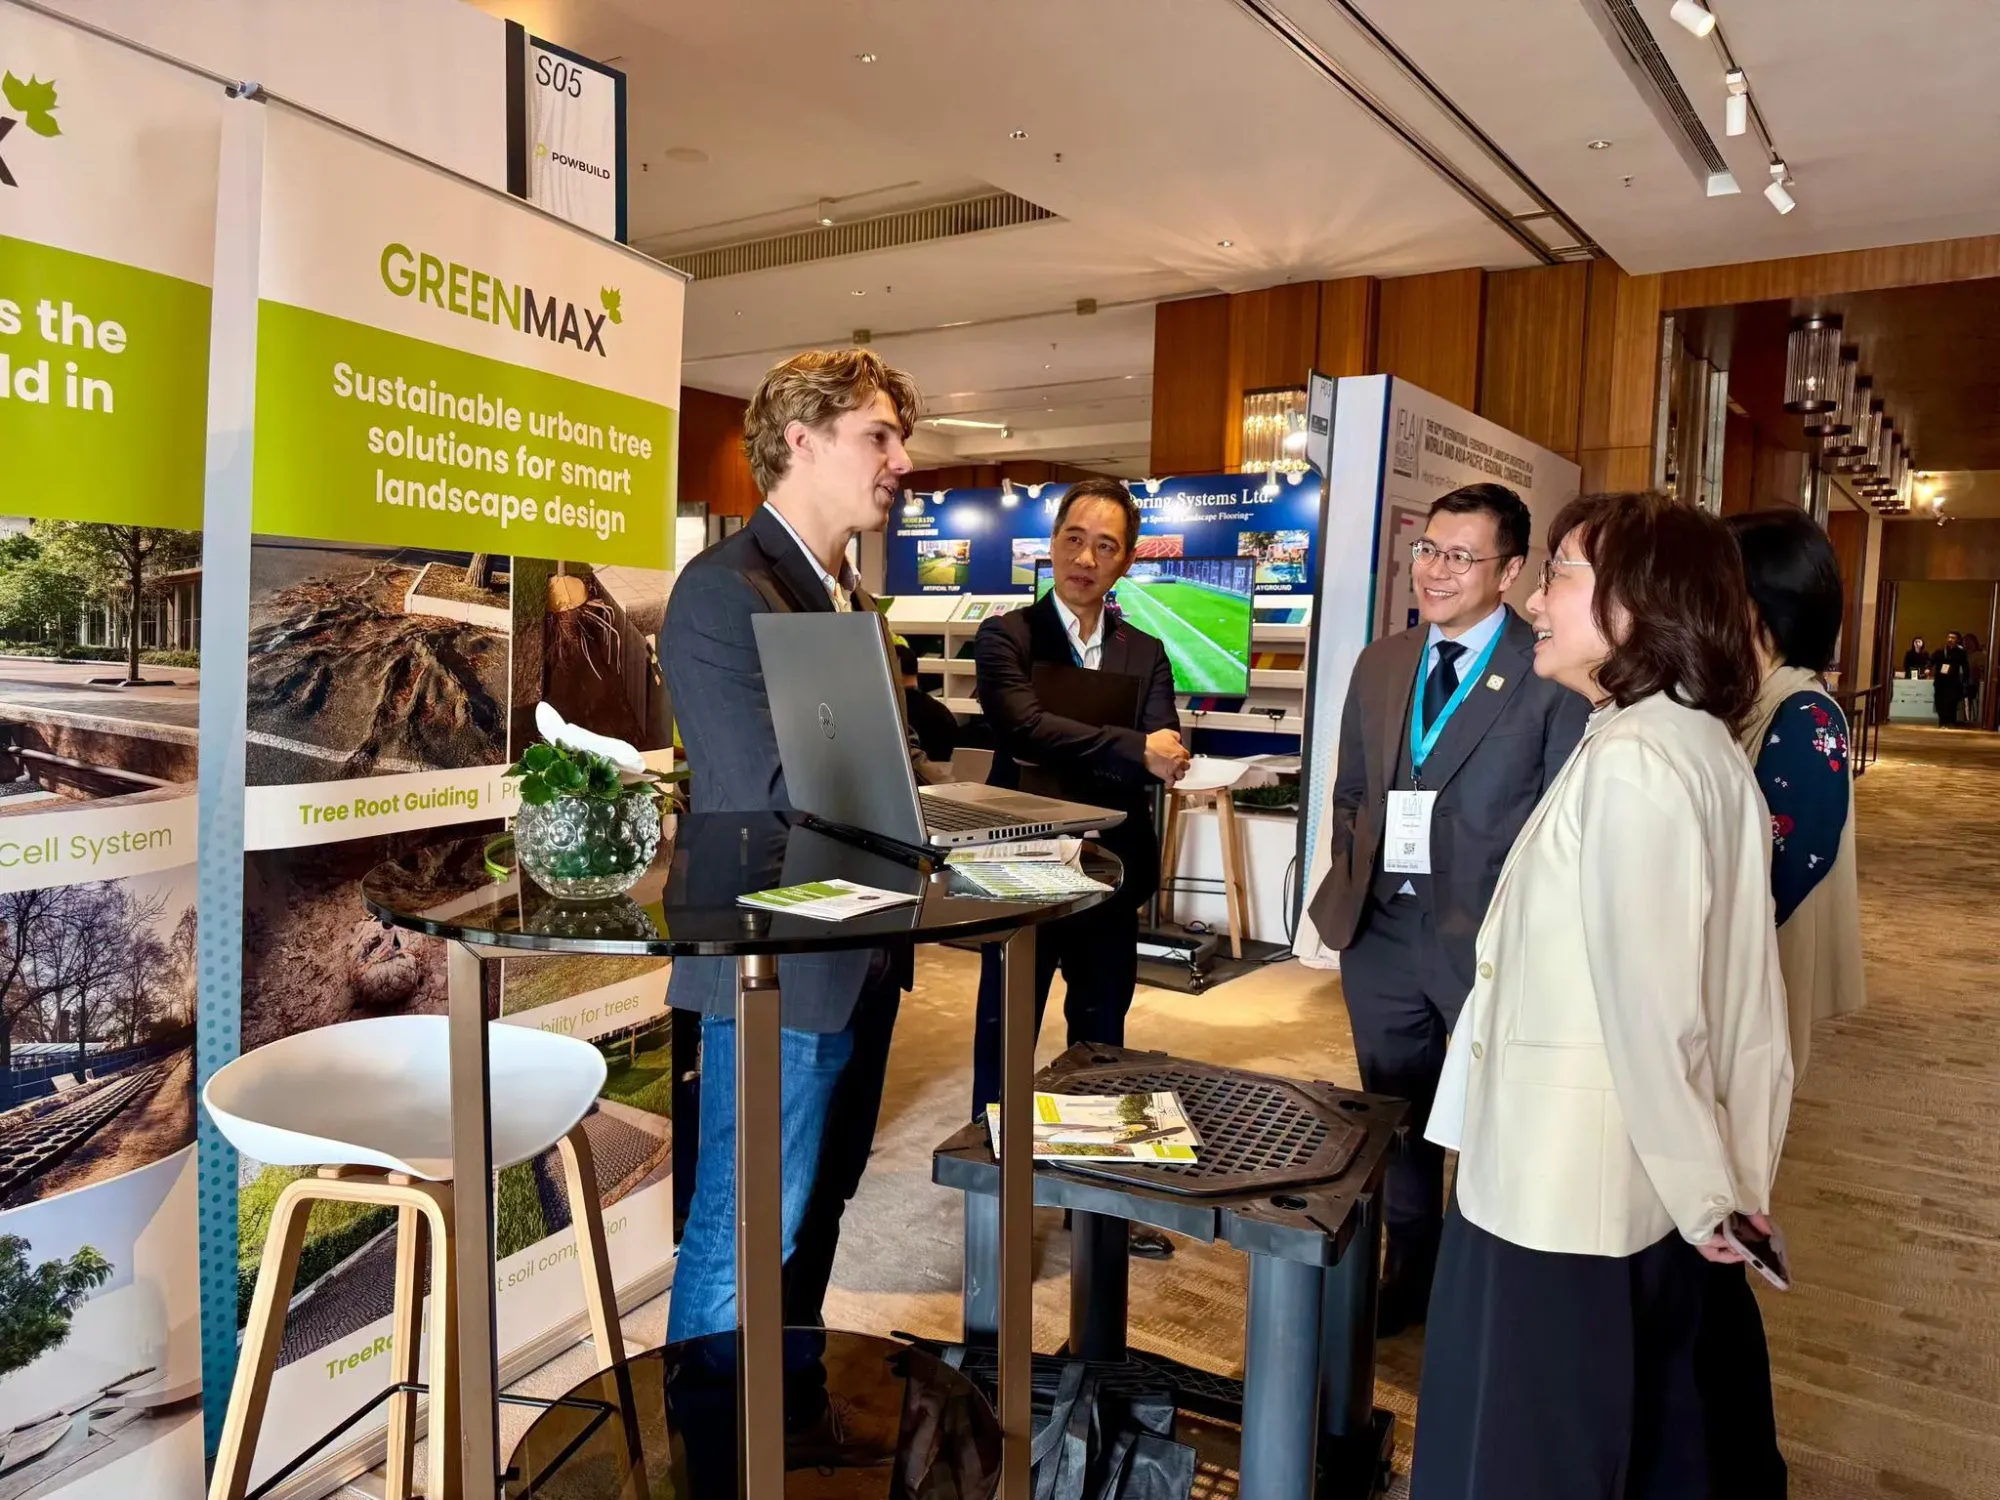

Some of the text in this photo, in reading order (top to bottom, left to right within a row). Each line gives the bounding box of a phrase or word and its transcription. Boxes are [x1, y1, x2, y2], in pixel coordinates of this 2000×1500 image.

[536, 55, 583, 98] S05
[552, 151, 611, 180] POWBUILD
[380, 242, 607, 358] GREENMAX
[36, 299, 127, 354] the
[65, 361, 114, 414] in
[333, 362, 653, 460] Sustainable urban tree
[368, 425, 632, 496] solutions for smart
[376, 468, 626, 541] landscape design
[1177, 491, 1237, 509] Systems
[1242, 488, 1273, 504] Ltd.
[299, 801, 349, 826] Tree
[353, 795, 400, 818] Root
[404, 784, 479, 811] Guiding
[0, 827, 172, 867] Cell System
[580, 1006, 602, 1025] for
[604, 994, 640, 1017] trees
[508, 1260, 534, 1287] soil
